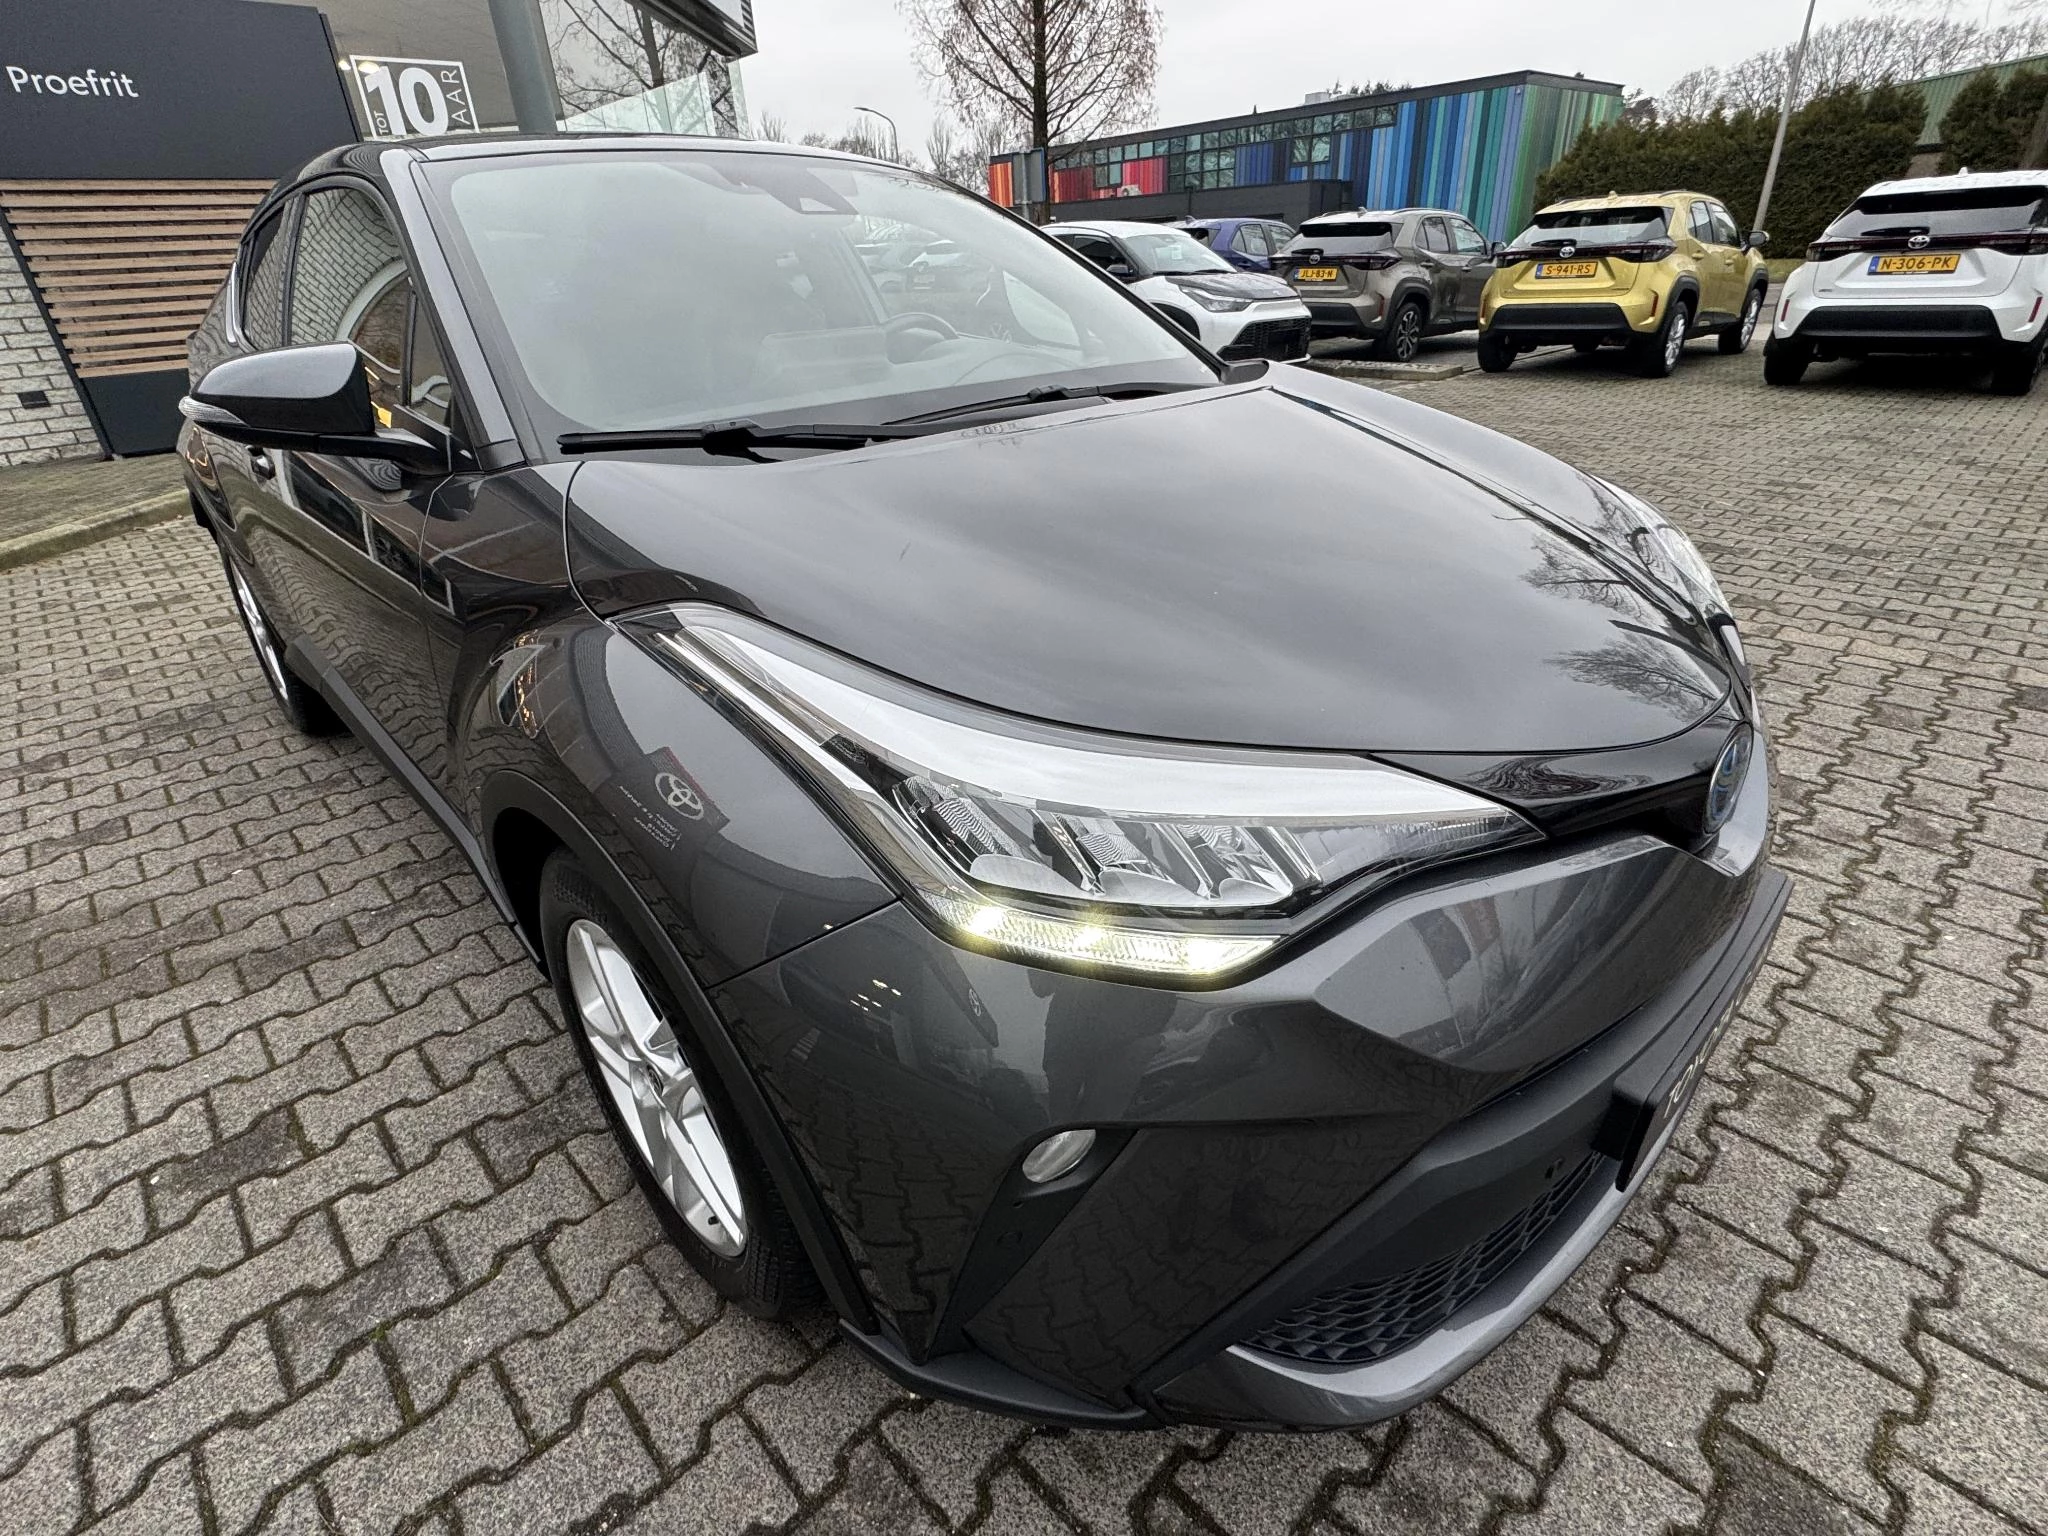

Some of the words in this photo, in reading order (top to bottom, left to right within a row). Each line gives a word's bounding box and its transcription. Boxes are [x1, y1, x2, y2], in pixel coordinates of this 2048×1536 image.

[6, 66, 140, 98] Proefrit
[364, 65, 448, 136] 10
[373, 110, 389, 136] TOT
[1545, 264, 1592, 275] S-941-RS
[1880, 256, 1954, 270] N-306-PK
